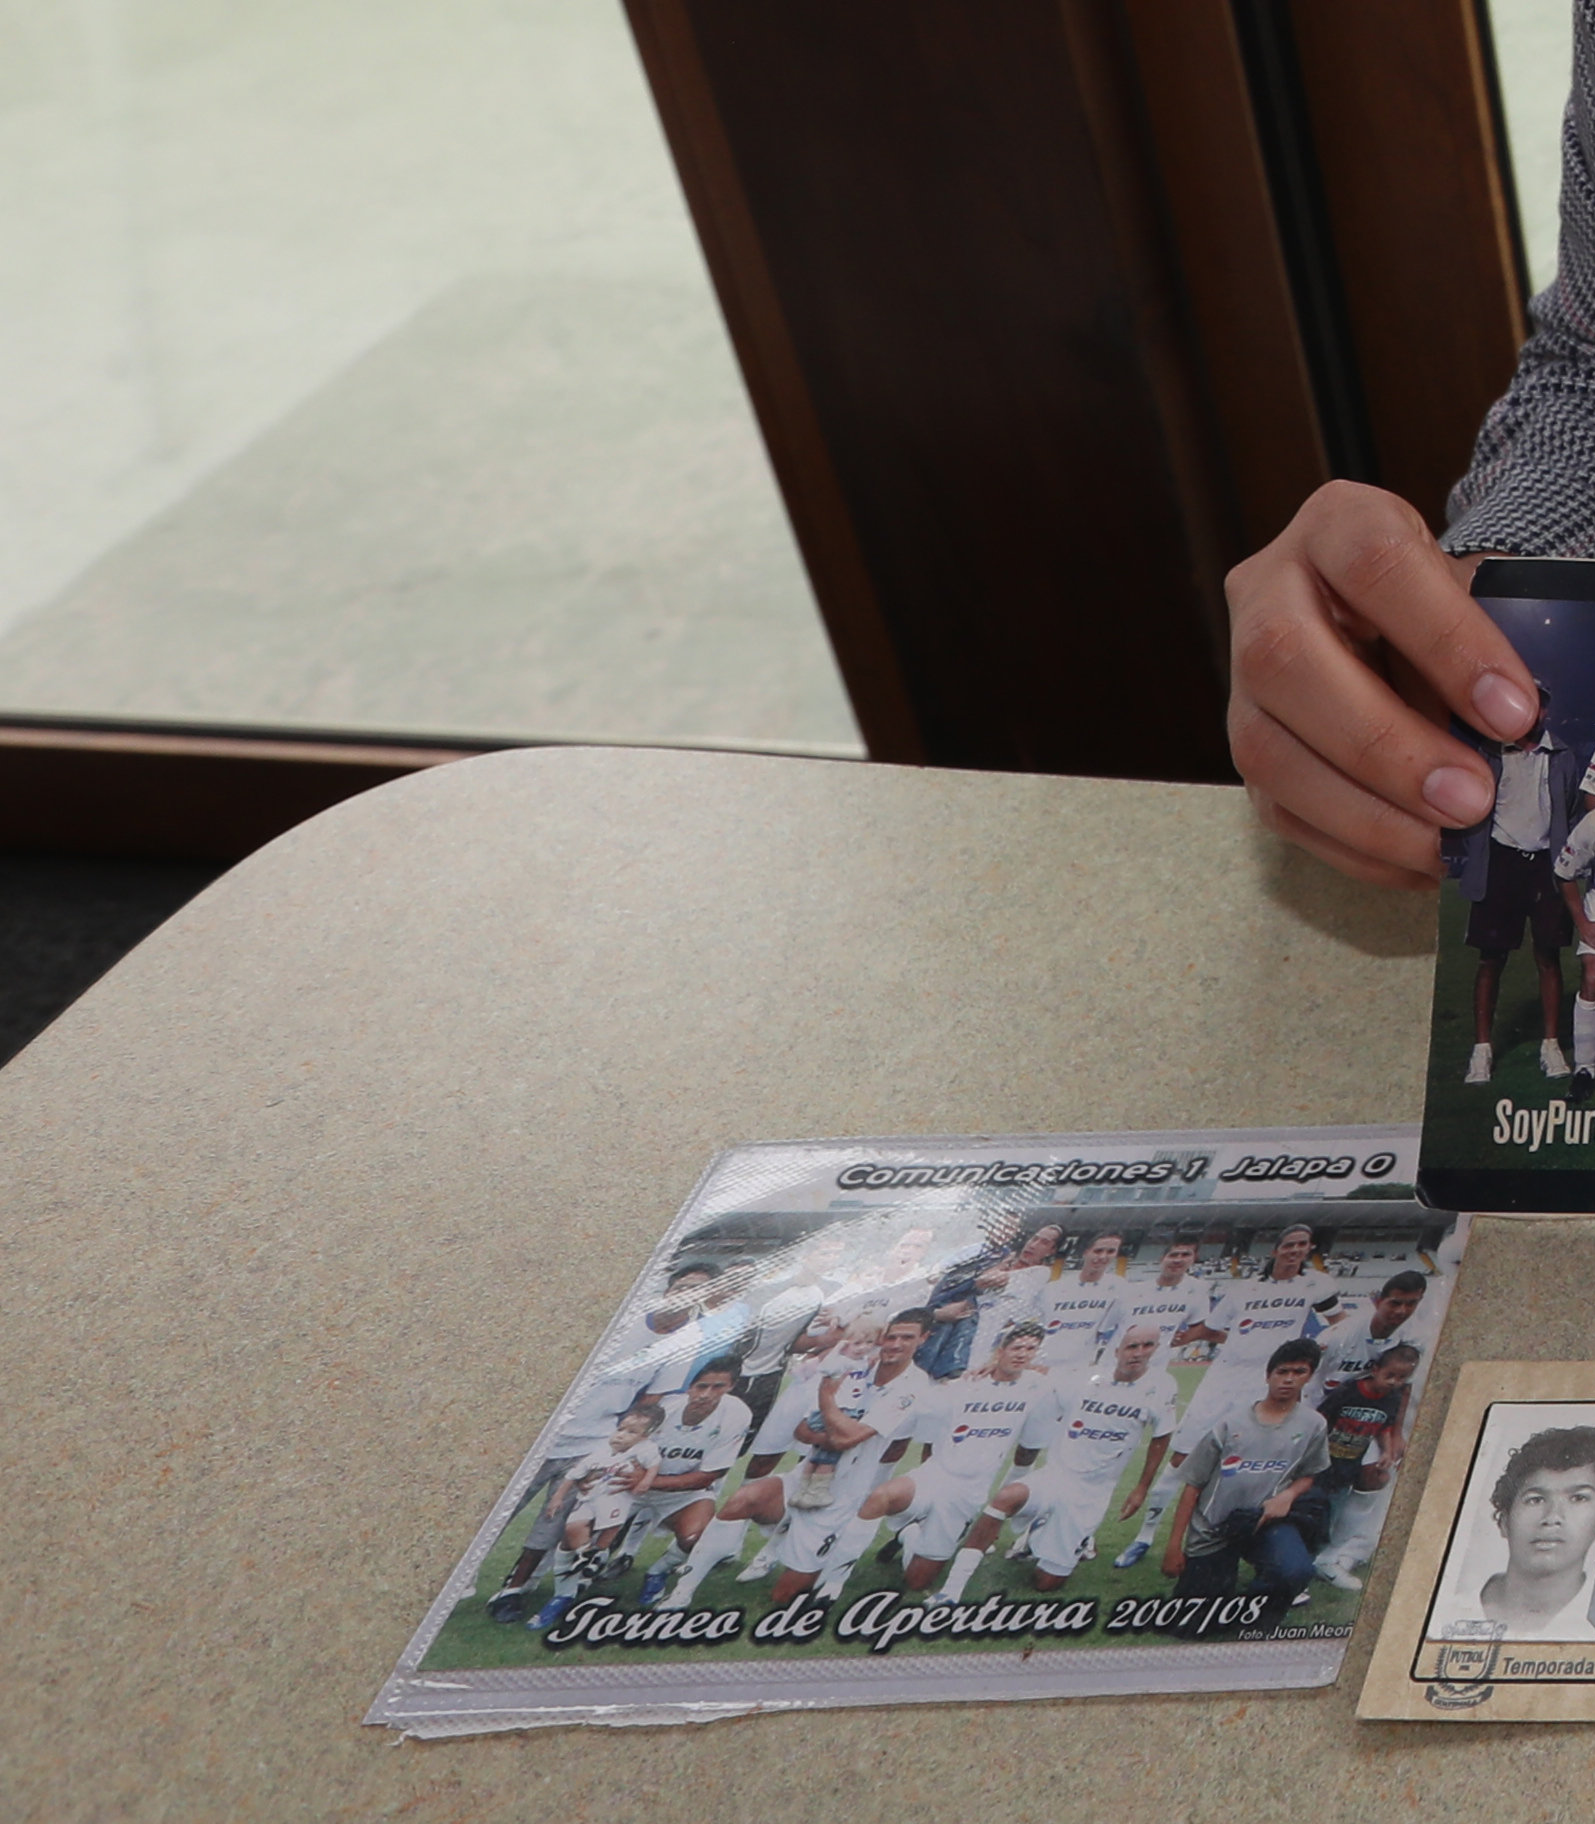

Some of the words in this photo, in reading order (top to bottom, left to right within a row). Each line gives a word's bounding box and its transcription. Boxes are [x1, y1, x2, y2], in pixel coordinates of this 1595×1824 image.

[840, 1158, 1173, 1188] Comunicaciones
[1223, 1155, 1354, 1183] Jalapa
[1244, 1297, 1306, 1311] TELGUA
[962, 1400, 1028, 1415] TELGUA
[1080, 1398, 1143, 1421] TELGUA
[547, 1594, 741, 1644] Torneo
[754, 1593, 825, 1638] de
[838, 1591, 1096, 1651] Apertura
[1107, 1594, 1269, 1634] 2007/08
[1502, 1656, 1595, 1679] Temporada
